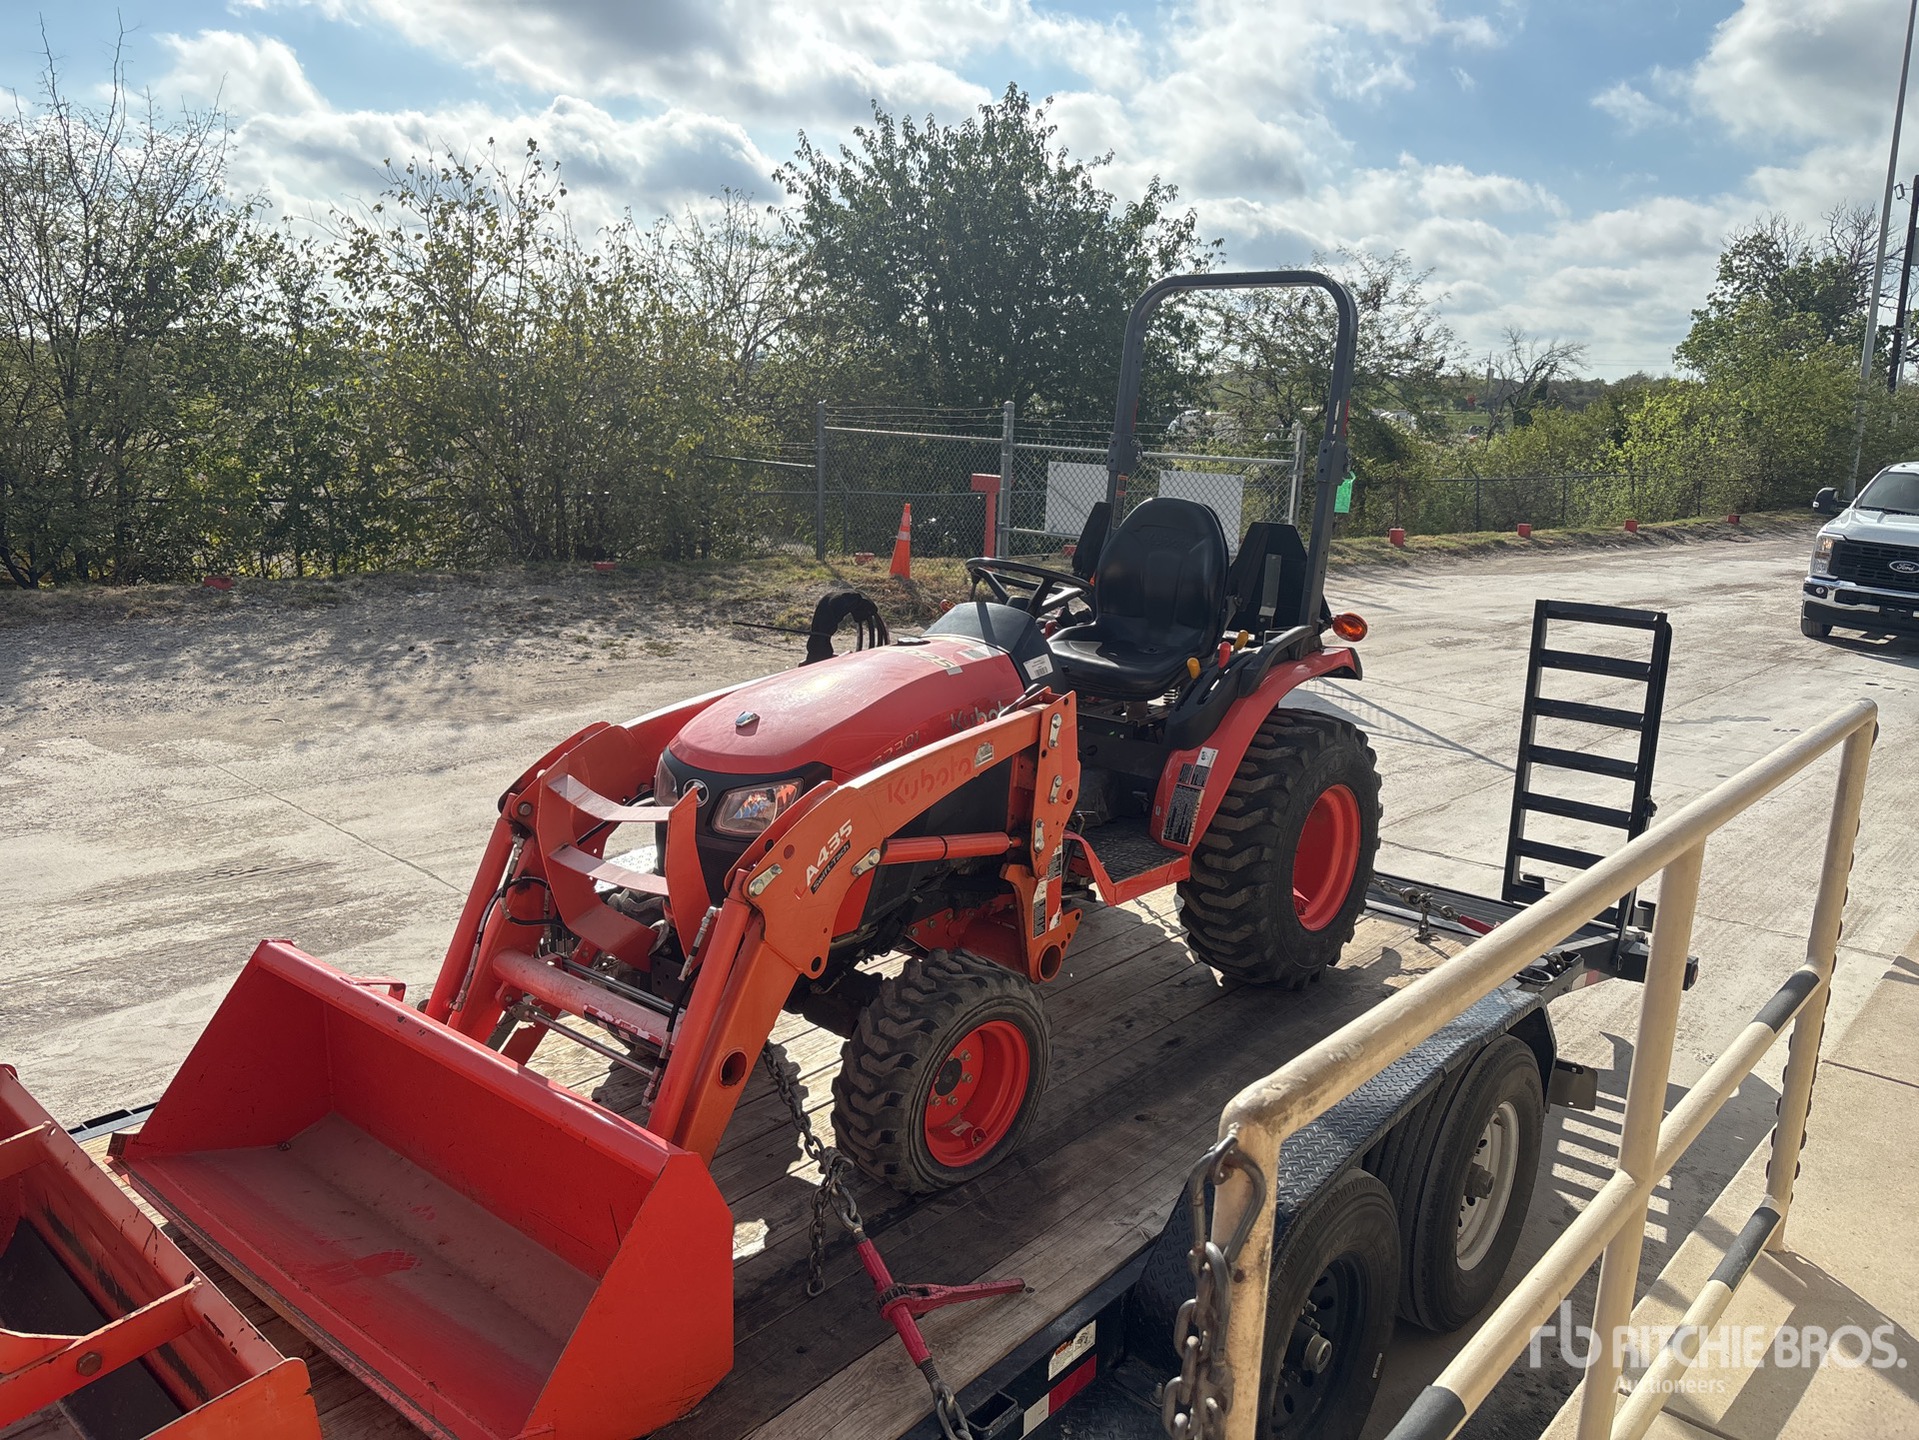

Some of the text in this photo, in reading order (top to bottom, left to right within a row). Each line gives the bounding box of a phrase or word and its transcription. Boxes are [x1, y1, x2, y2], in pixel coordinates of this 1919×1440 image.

[1896, 563, 1916, 572] Ford
[949, 700, 1006, 732] Kubot
[887, 755, 972, 805] Kubota
[794, 818, 853, 900] LA435
[812, 841, 850, 893] Swift-Tach
